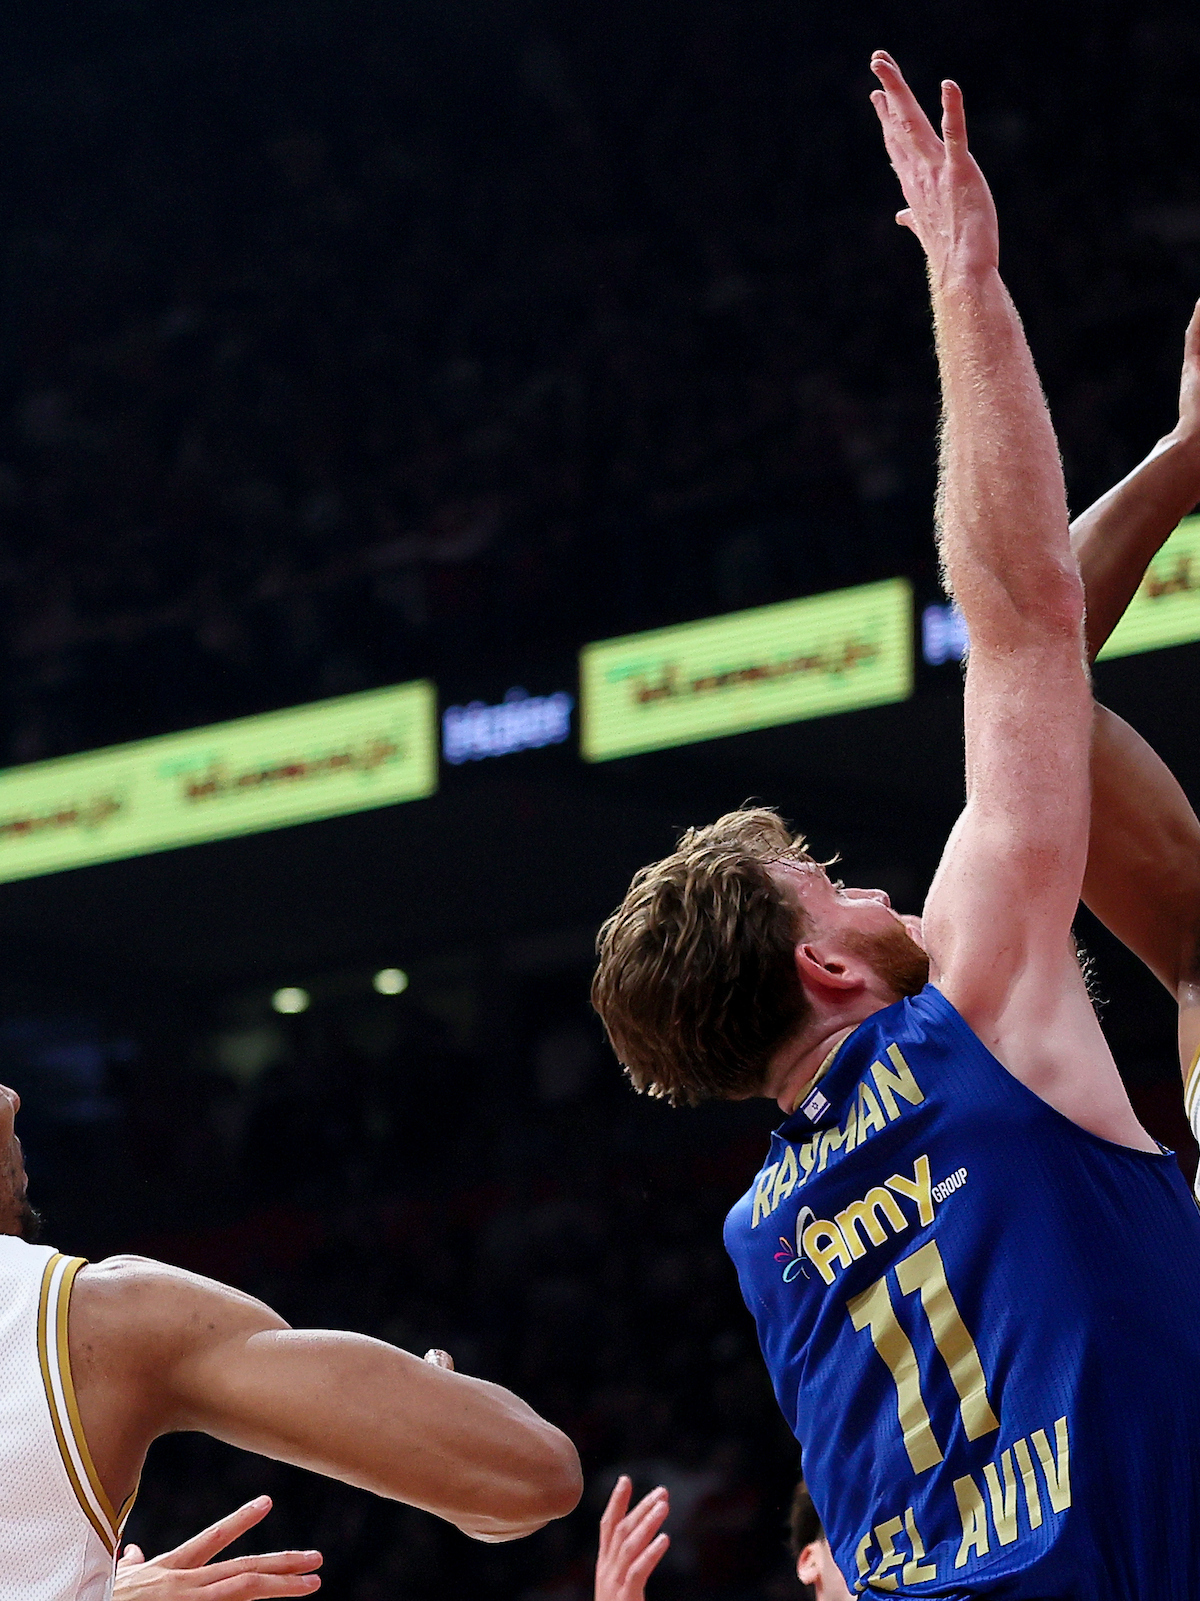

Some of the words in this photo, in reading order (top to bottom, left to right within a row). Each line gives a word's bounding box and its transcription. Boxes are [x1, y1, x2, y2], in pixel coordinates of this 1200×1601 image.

[751, 1042, 925, 1229] RAYMAN
[931, 1166, 969, 1204] GROUP
[845, 1238, 1000, 1475] 11
[952, 1415, 1072, 1570] AVIV
